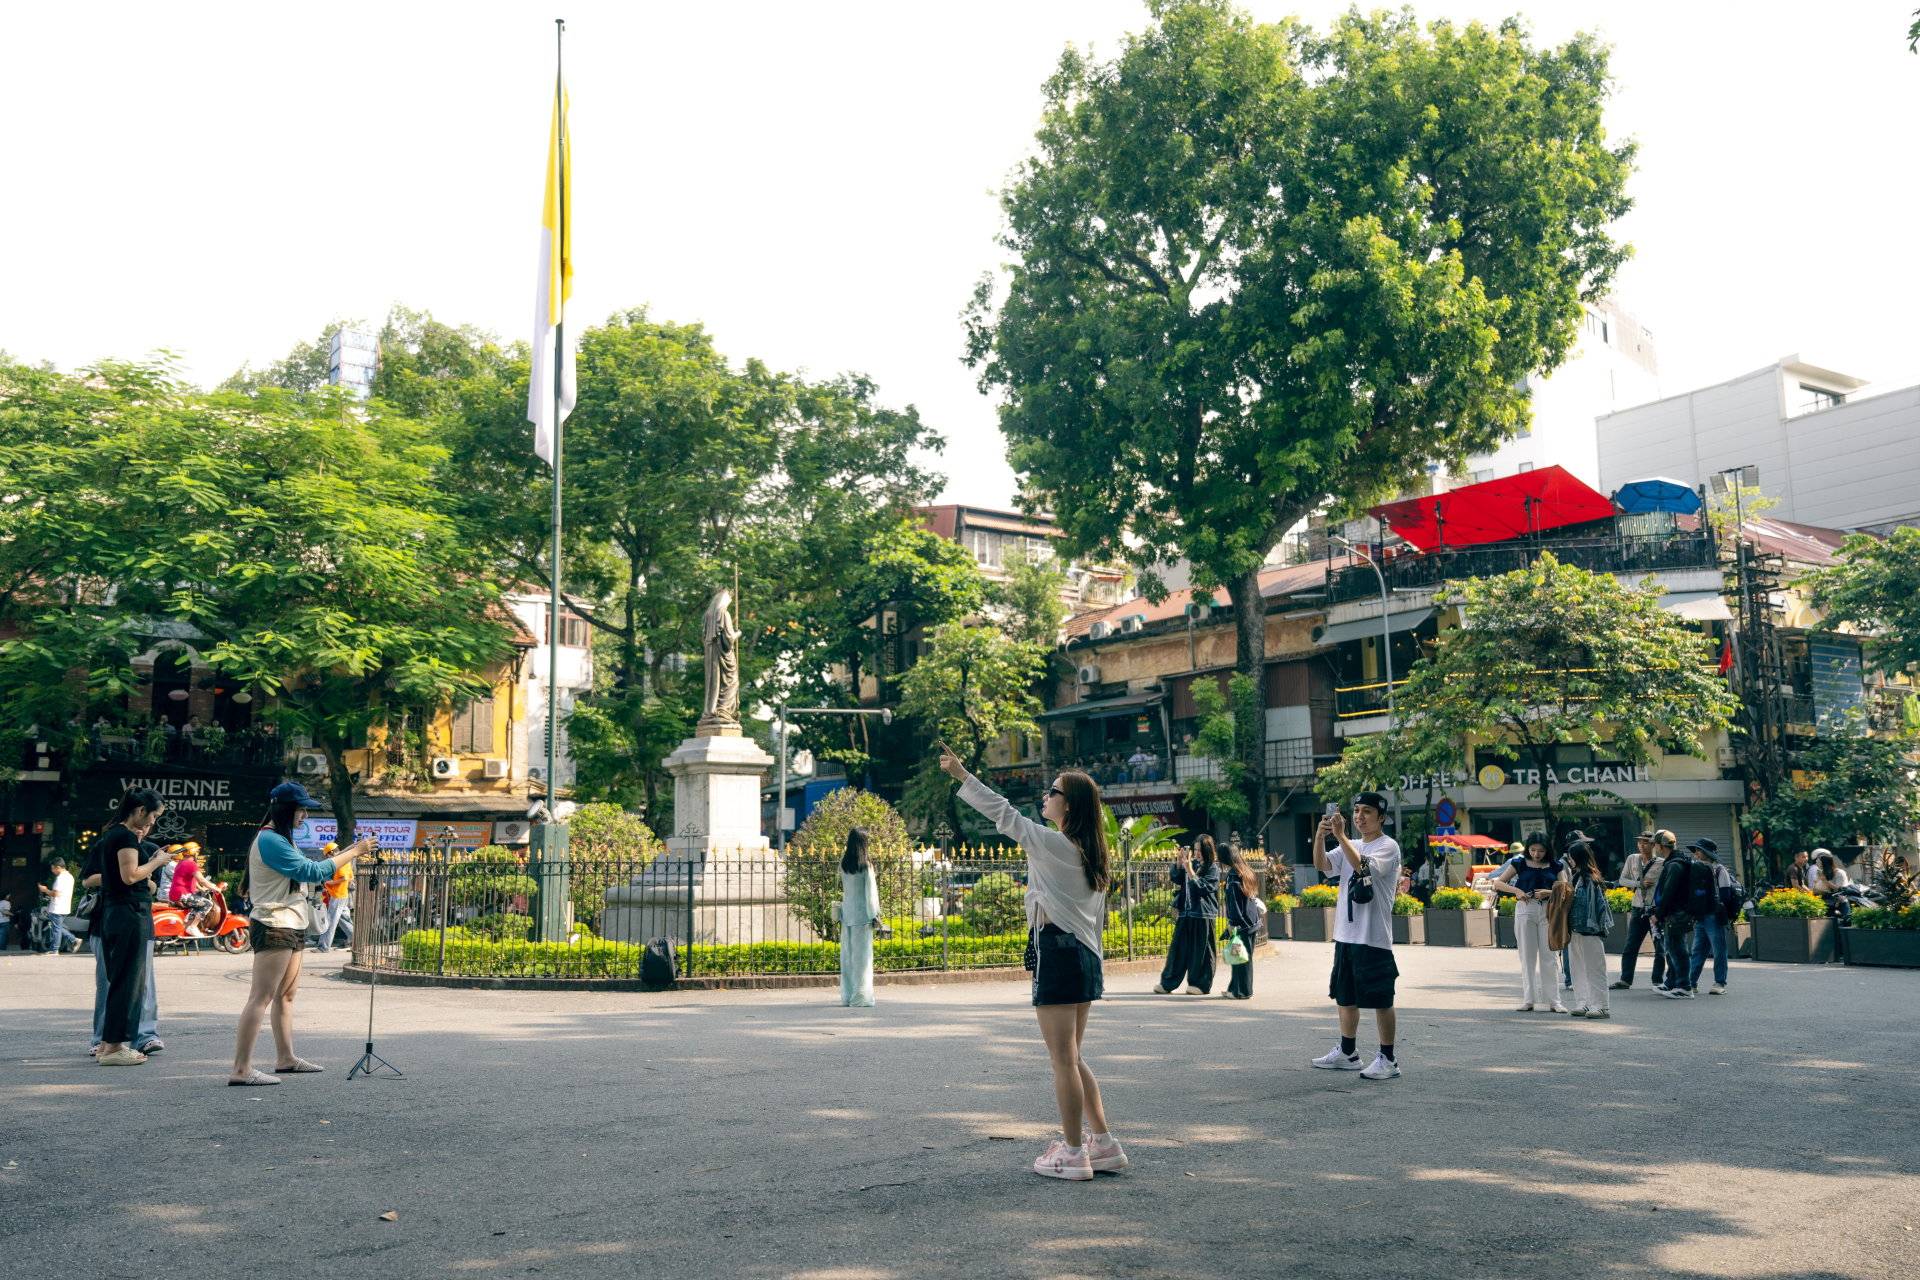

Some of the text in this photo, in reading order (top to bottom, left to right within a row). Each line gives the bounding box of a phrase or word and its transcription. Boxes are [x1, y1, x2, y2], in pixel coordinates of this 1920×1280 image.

[1484, 771, 1500, 782] 26
[1513, 763, 1649, 784] TRÀ CHANH
[164, 799, 235, 811] ESTAURANT
[315, 825, 337, 833] OCE
[384, 826, 410, 834] TOUR
[378, 834, 408, 842] FFICE
